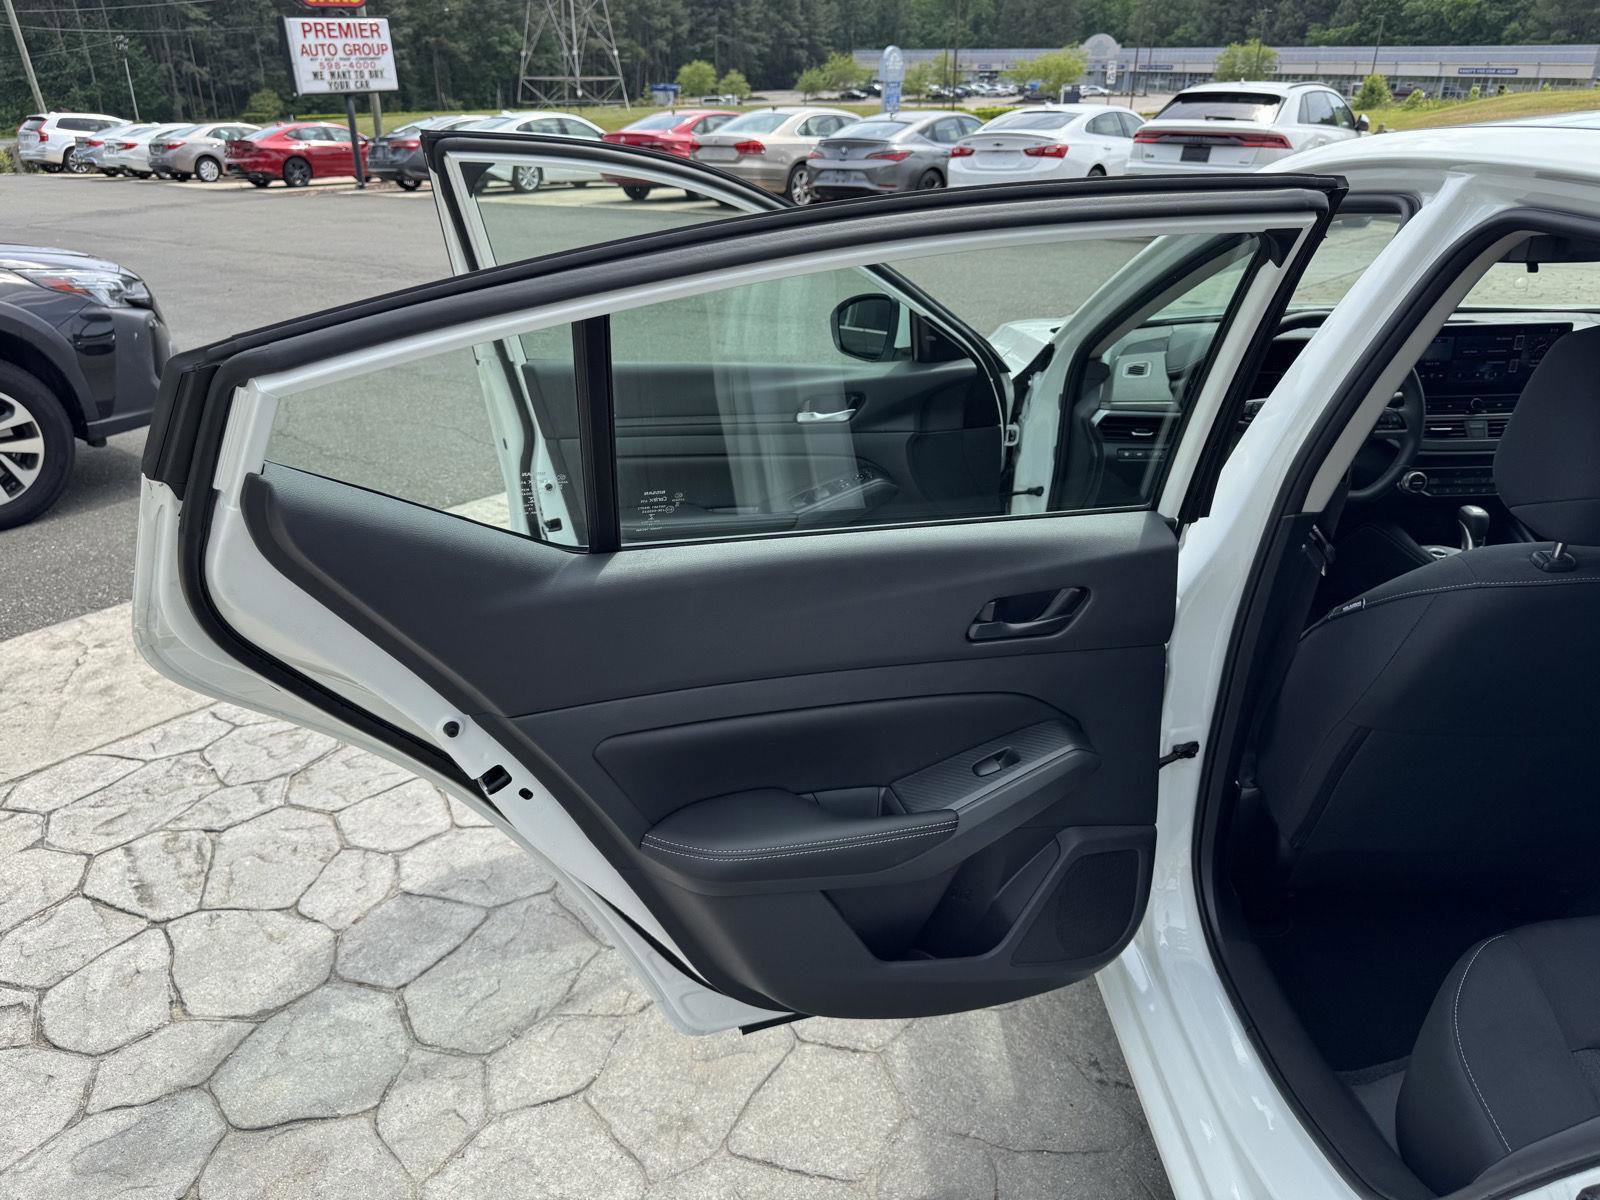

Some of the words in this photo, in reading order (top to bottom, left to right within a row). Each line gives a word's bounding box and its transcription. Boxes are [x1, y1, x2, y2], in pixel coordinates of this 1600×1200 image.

[301, 22, 381, 39] PREMIER
[300, 43, 337, 57] AUTO
[343, 42, 388, 56] GROUP
